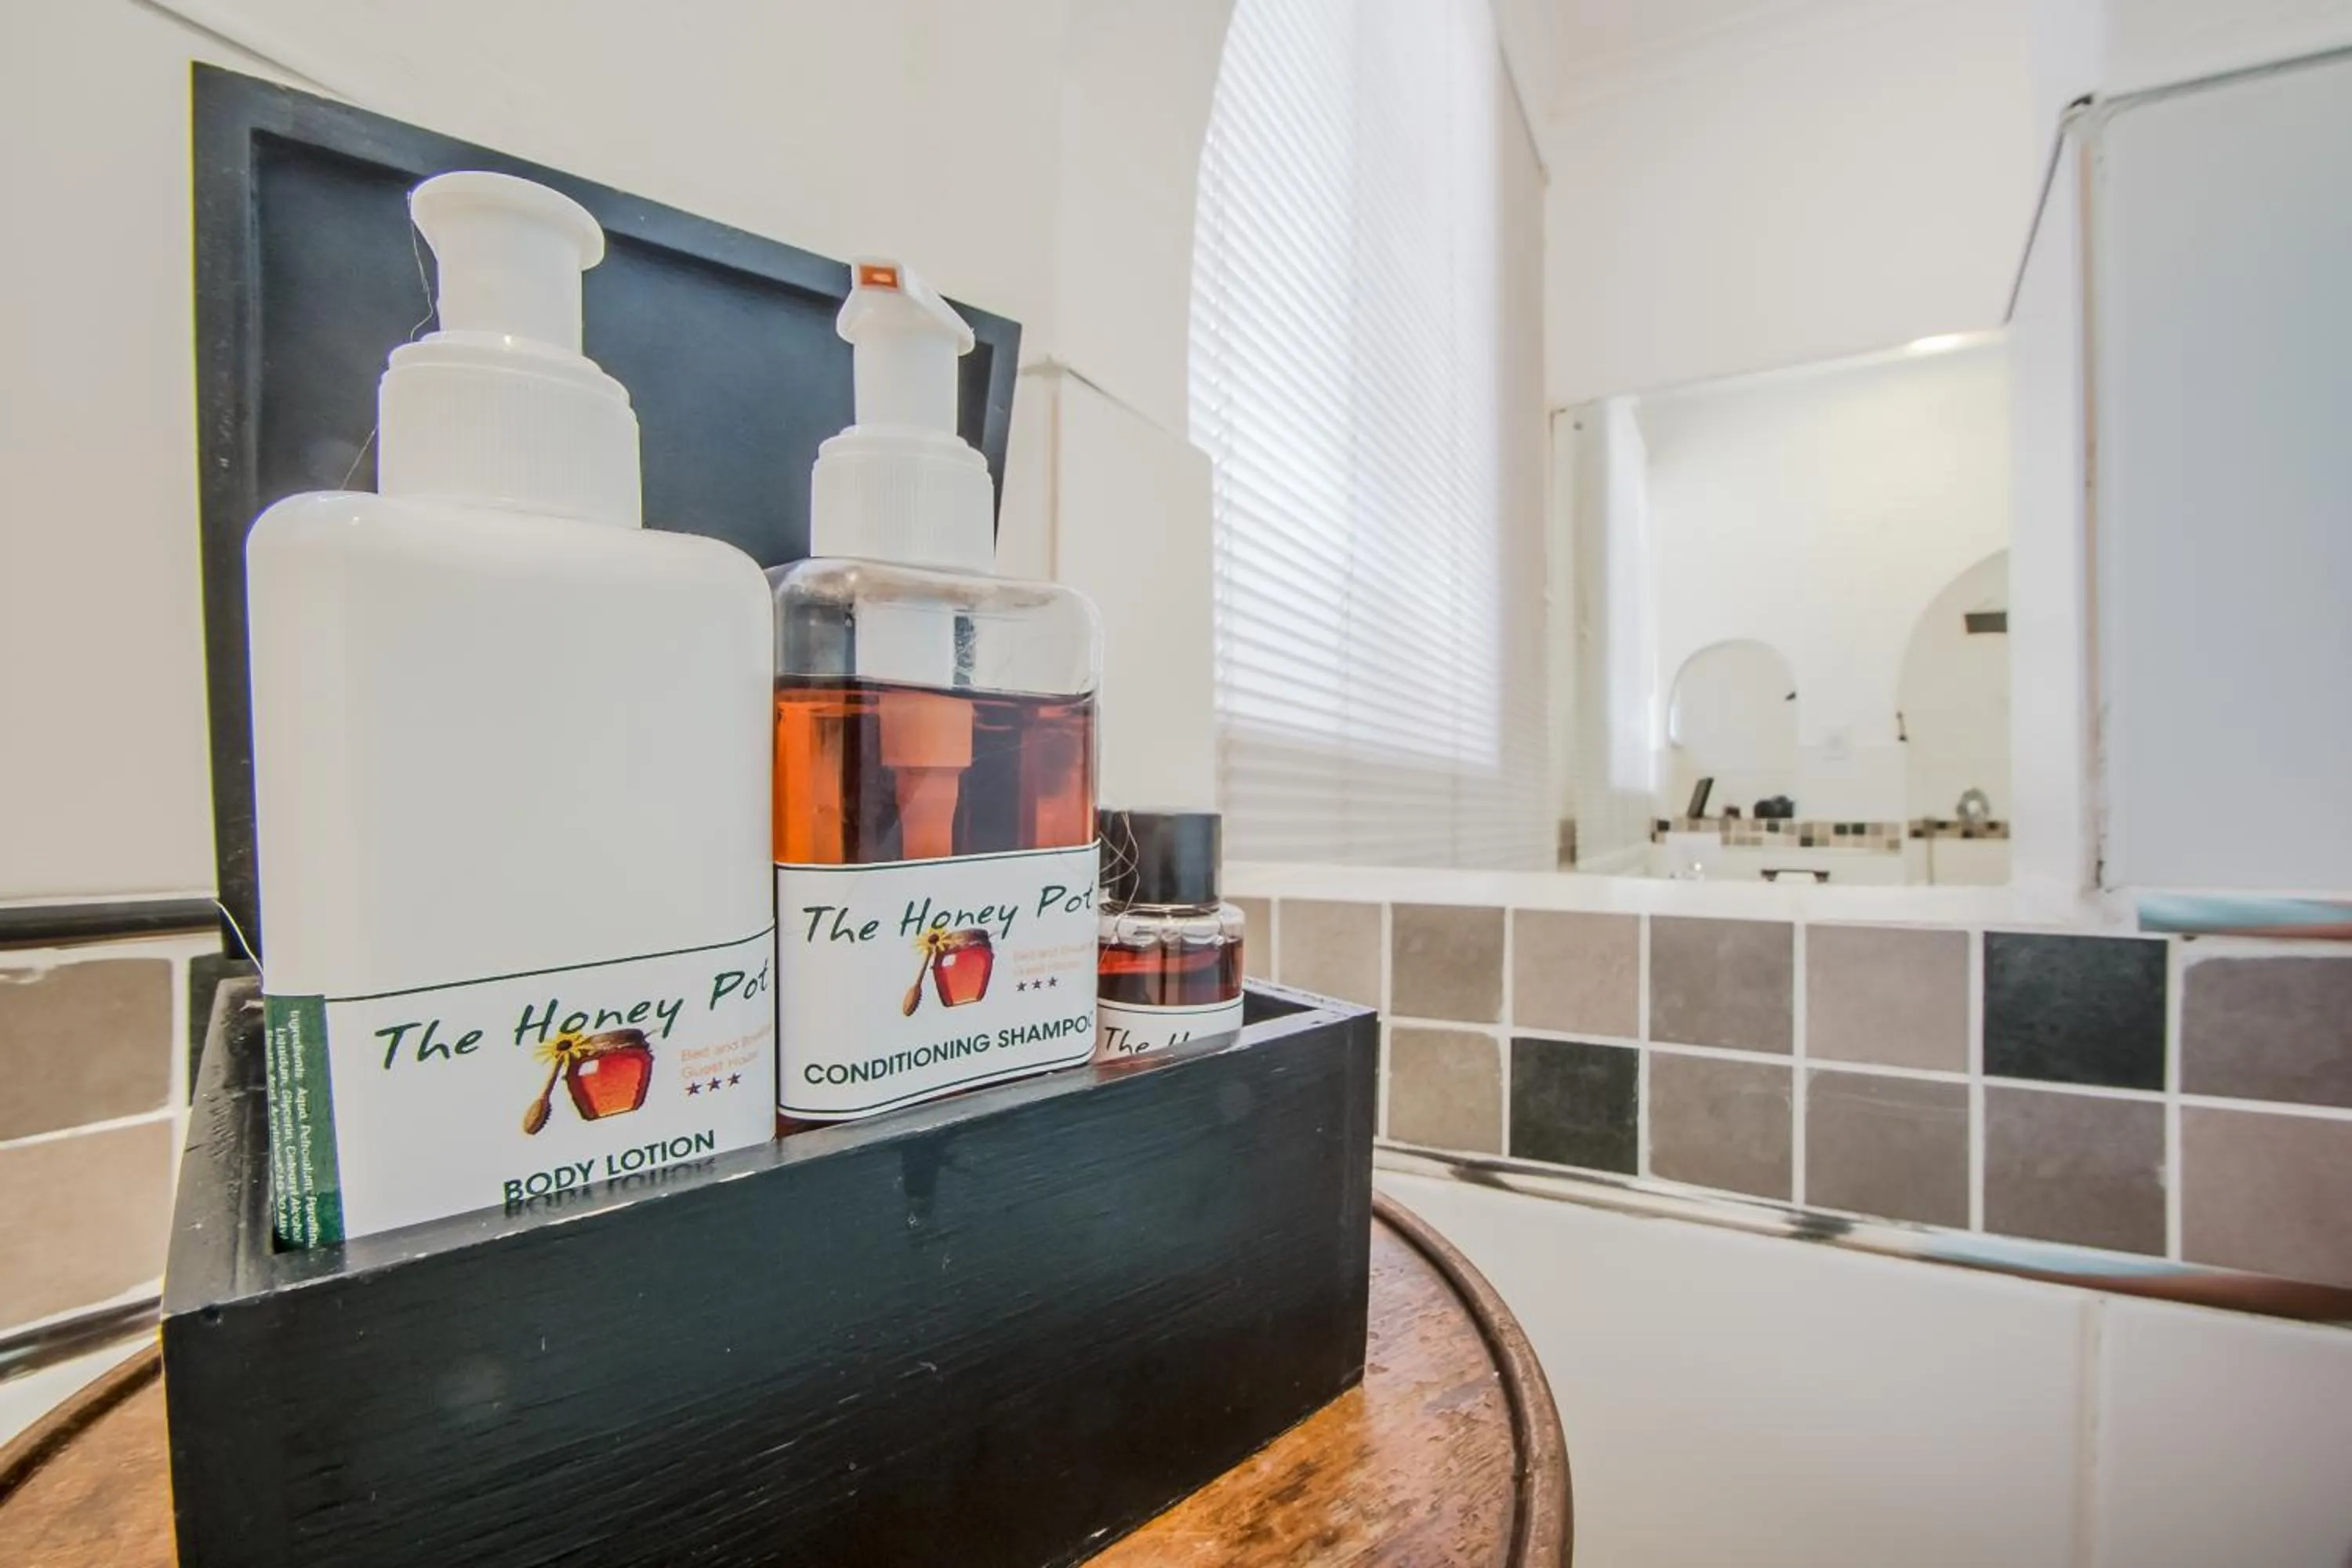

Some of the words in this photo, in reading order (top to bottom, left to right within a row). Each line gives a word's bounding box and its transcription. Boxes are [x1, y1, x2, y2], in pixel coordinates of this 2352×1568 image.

[803, 906, 880, 943] The
[900, 898, 1018, 940] Honey
[1036, 880, 1094, 917] Pot
[375, 1019, 484, 1069] The
[515, 998, 684, 1046] Honey
[710, 957, 769, 1011] Pot
[1105, 1026, 1150, 1054] The
[804, 1034, 990, 1084] CONDITIONING
[503, 1159, 594, 1203] BODY
[606, 1130, 715, 1175] LOTION
